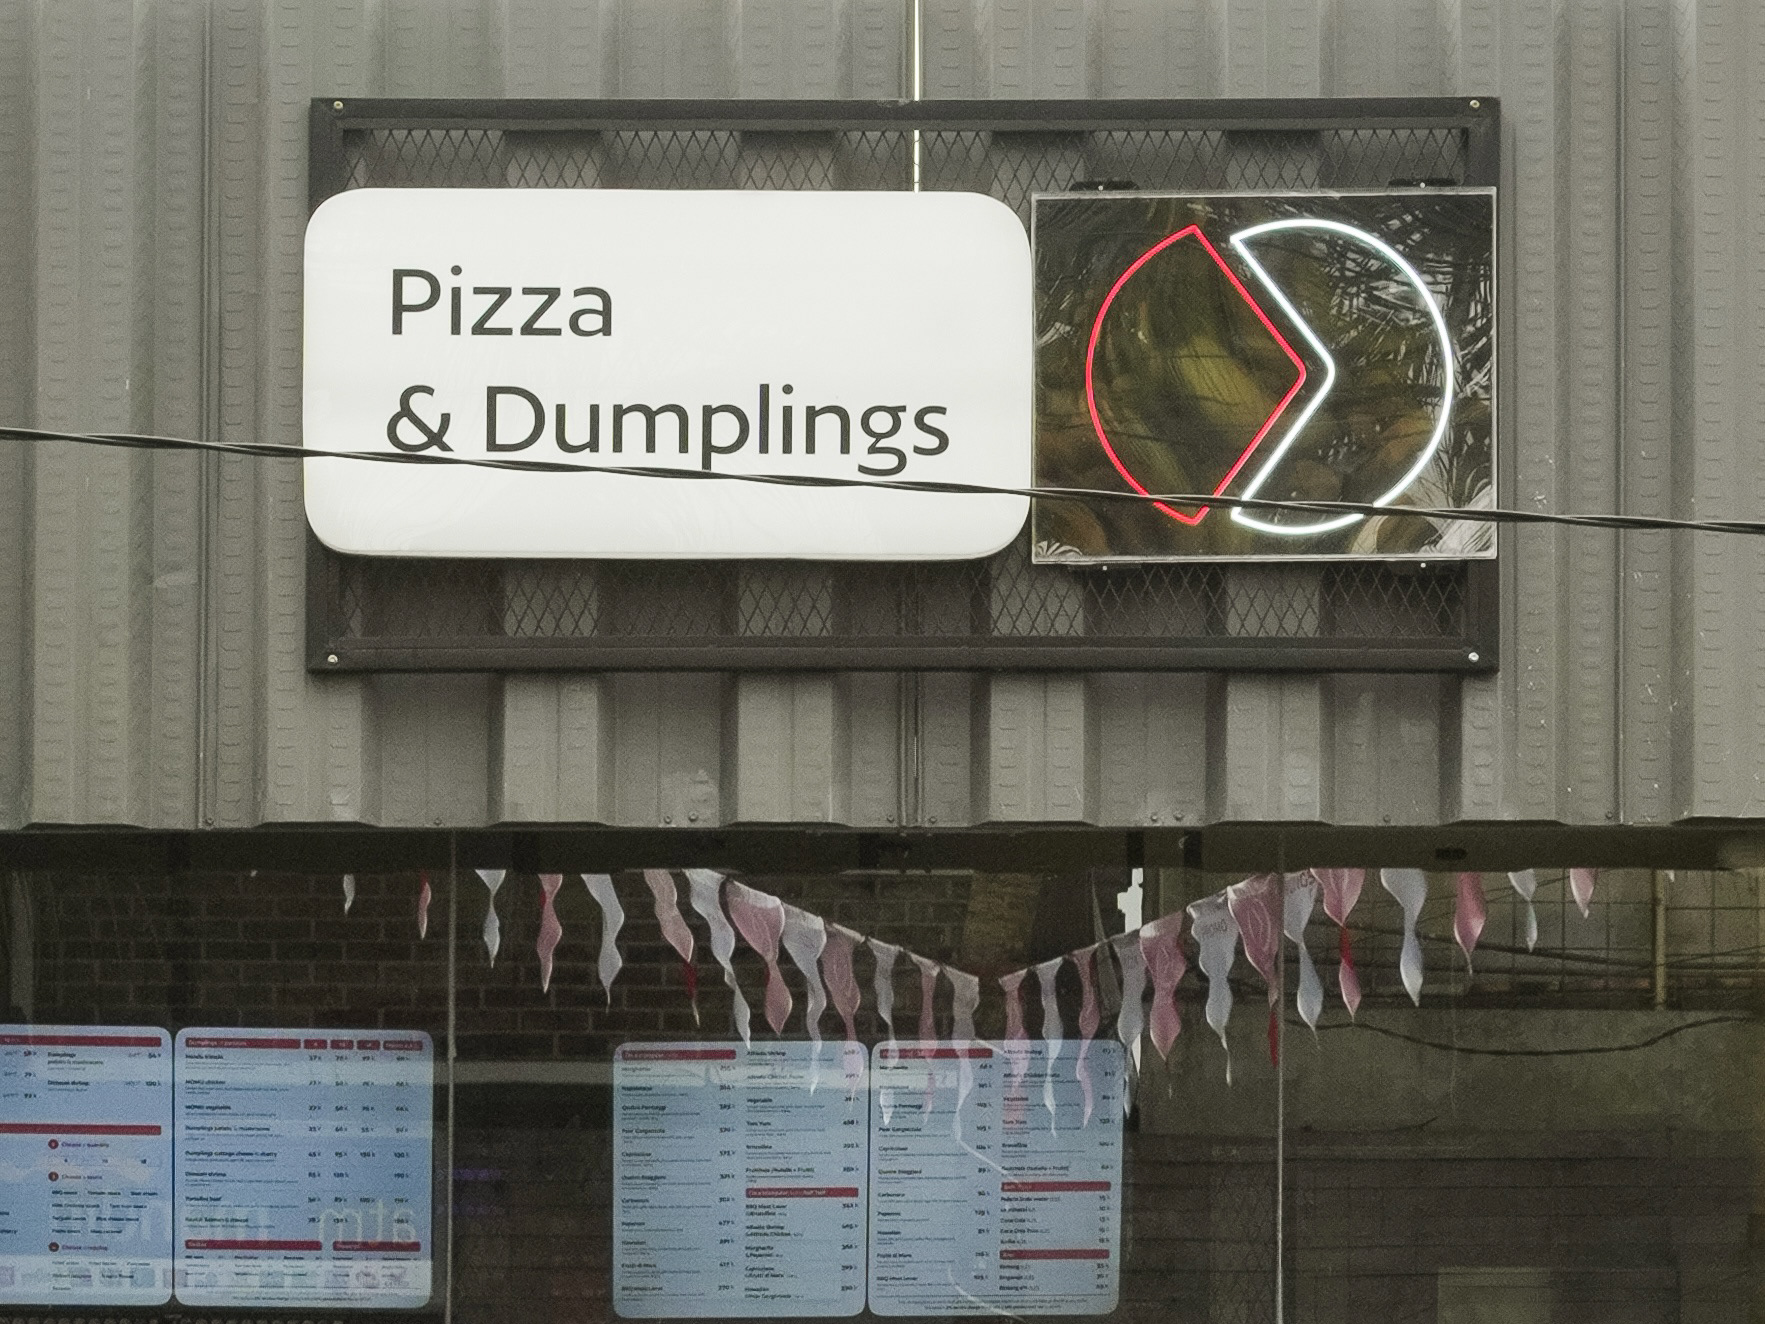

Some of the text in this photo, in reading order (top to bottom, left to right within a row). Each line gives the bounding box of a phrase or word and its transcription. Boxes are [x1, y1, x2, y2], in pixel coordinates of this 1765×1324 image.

[391, 265, 614, 337] Pizza
[386, 384, 951, 476] & Dumplings
